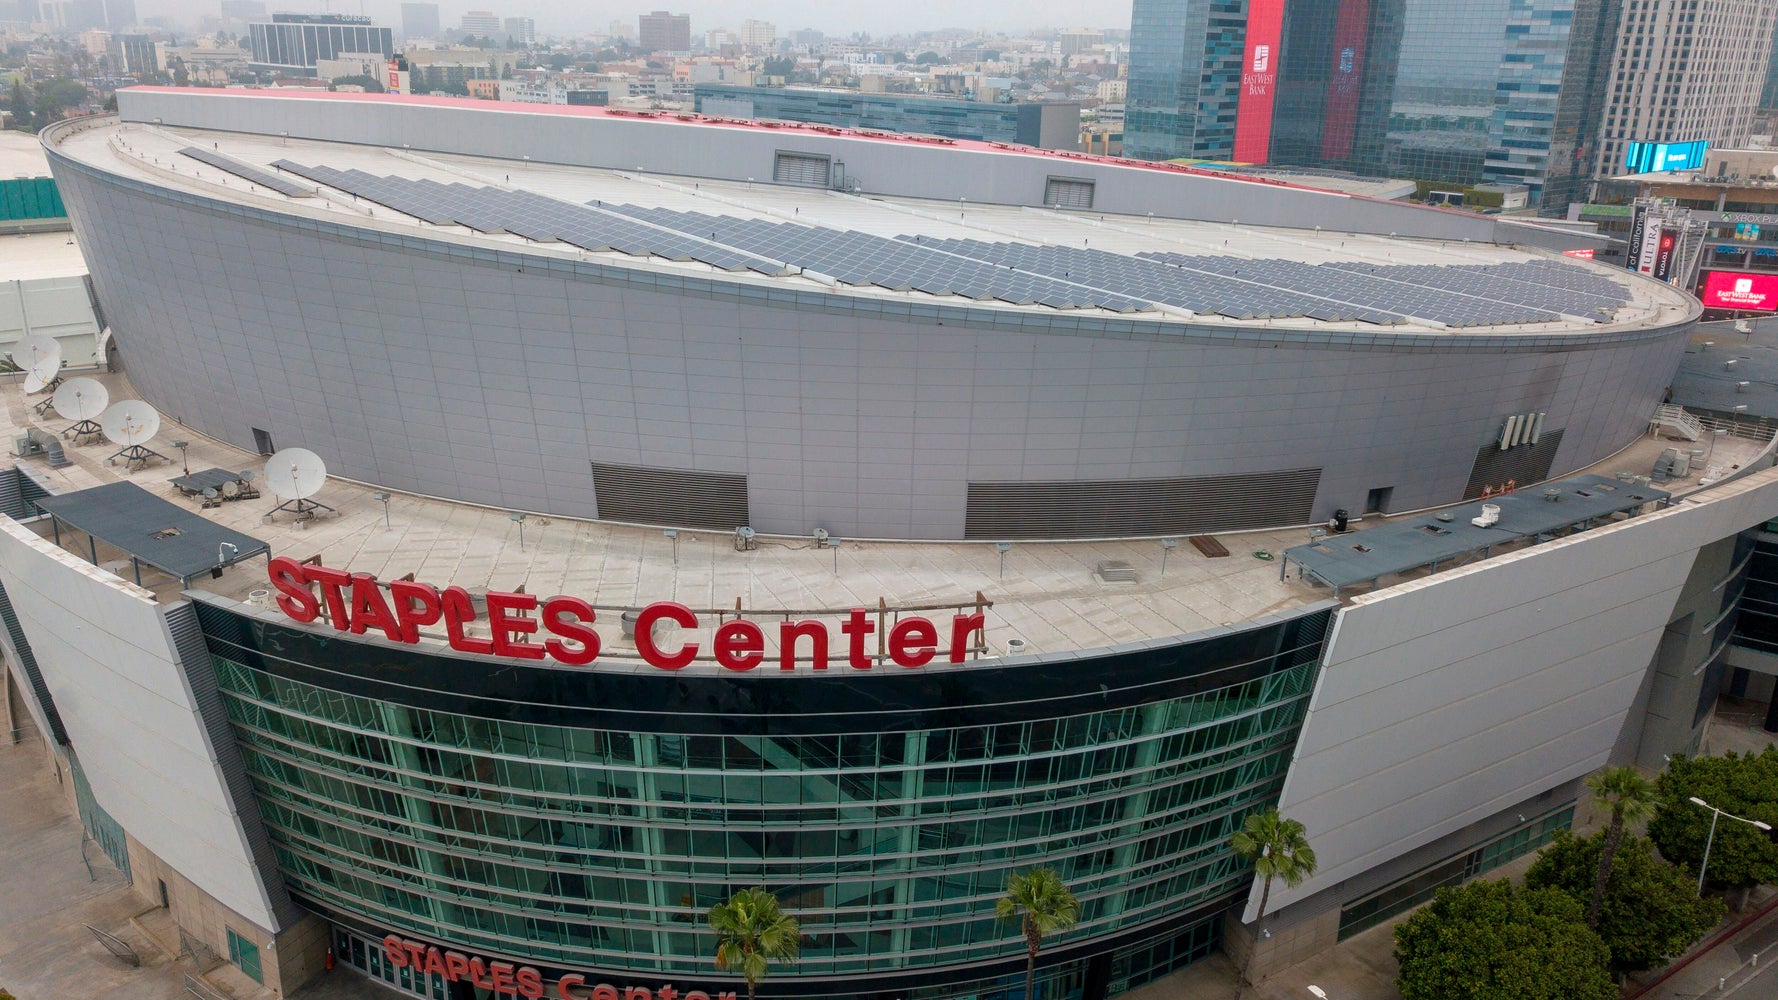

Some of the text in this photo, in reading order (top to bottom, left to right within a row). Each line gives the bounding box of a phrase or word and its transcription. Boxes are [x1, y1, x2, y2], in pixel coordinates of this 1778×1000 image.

[1629, 211, 1645, 265] of california
[1734, 213, 1760, 223] XBOX
[1643, 223, 1660, 265] ULTRA
[1659, 250, 1669, 276] TOYOTA
[268, 556, 985, 671] STAPLES Center
[383, 934, 545, 998] STAPLES
